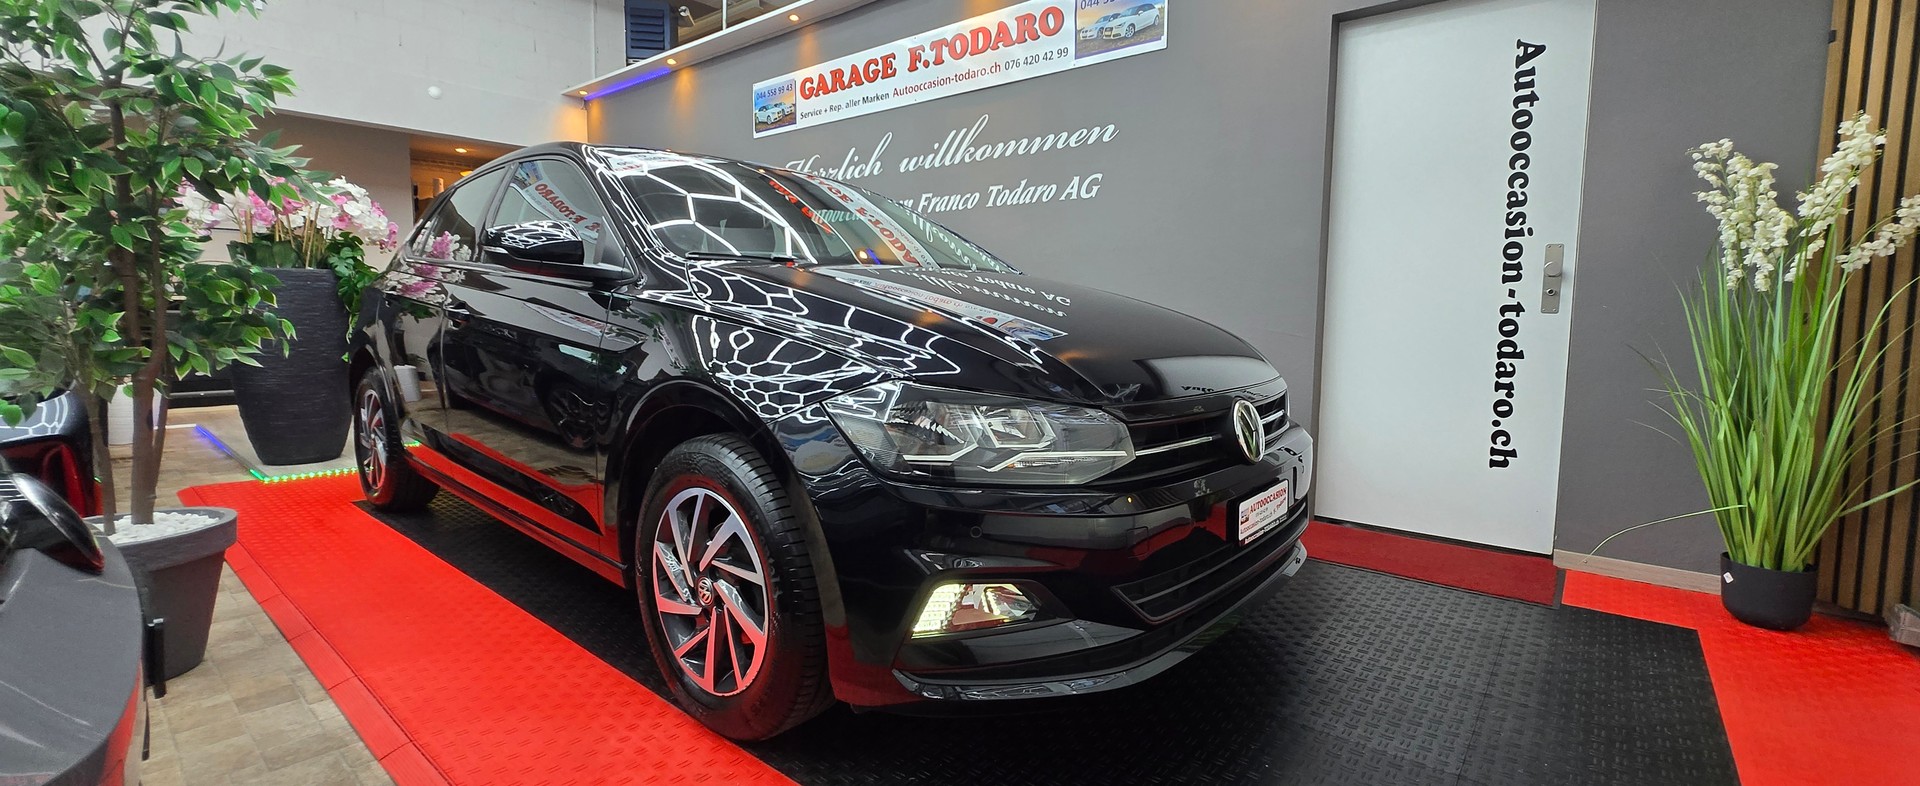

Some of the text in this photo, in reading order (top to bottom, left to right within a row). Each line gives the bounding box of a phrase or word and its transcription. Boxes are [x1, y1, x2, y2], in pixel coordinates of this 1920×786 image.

[799, 6, 1065, 101] GARAGE F.TODARO
[800, 109, 823, 120] Service
[829, 104, 844, 114] Rep.
[845, 99, 861, 109] aller
[862, 92, 890, 105] Marken
[892, 62, 1001, 98] Autooccasion-todaro.ch
[1004, 57, 1021, 71] 076
[1023, 54, 1040, 67] 420
[1042, 51, 1054, 62] 42
[1057, 47, 1069, 58] 99
[756, 83, 793, 101] 044 558 99 43
[899, 114, 1120, 173] willkommen
[917, 173, 1104, 214] Franco Todaro AG
[1489, 38, 1547, 469] Autooccasion-todaro.ch
